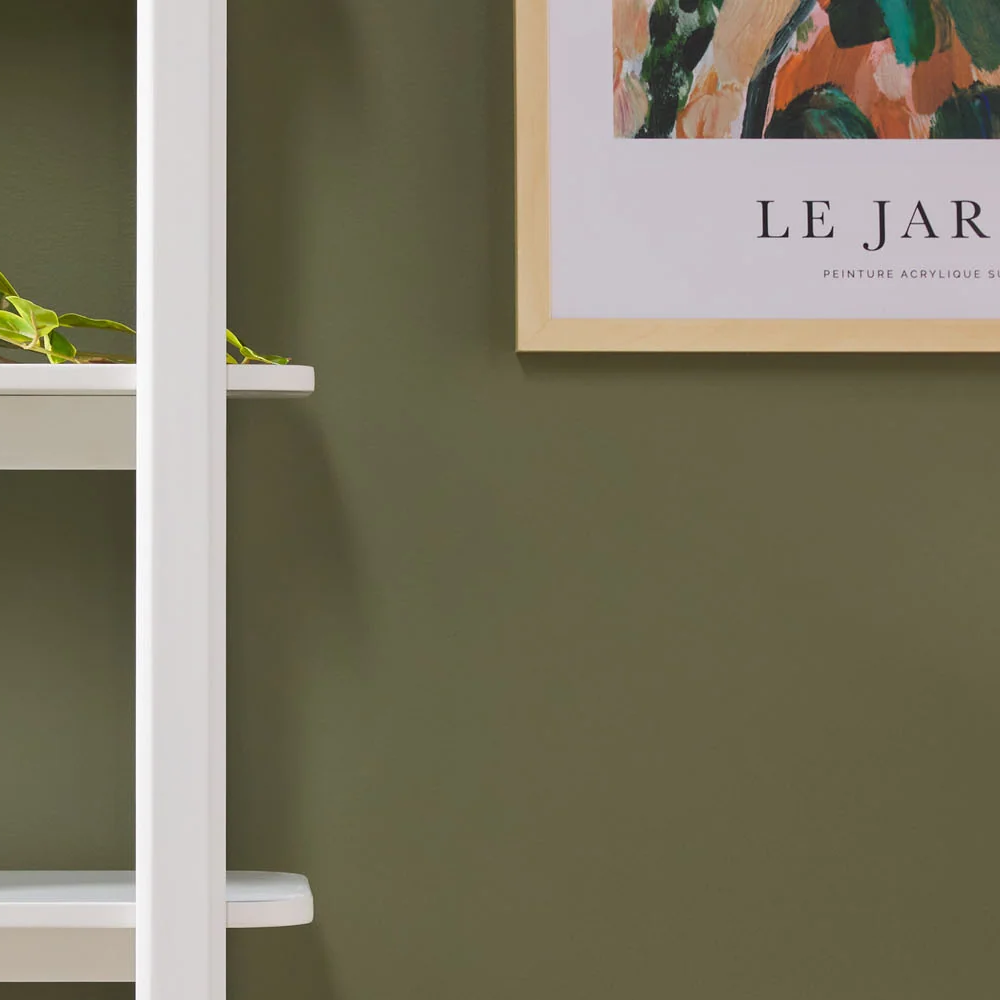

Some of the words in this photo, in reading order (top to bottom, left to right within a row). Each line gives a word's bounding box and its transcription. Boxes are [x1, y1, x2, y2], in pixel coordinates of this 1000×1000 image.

[755, 199, 835, 239] LE
[861, 199, 992, 252] JAR
[823, 269, 895, 279] PEINTURE
[900, 269, 982, 280] ACRYLIQUE
